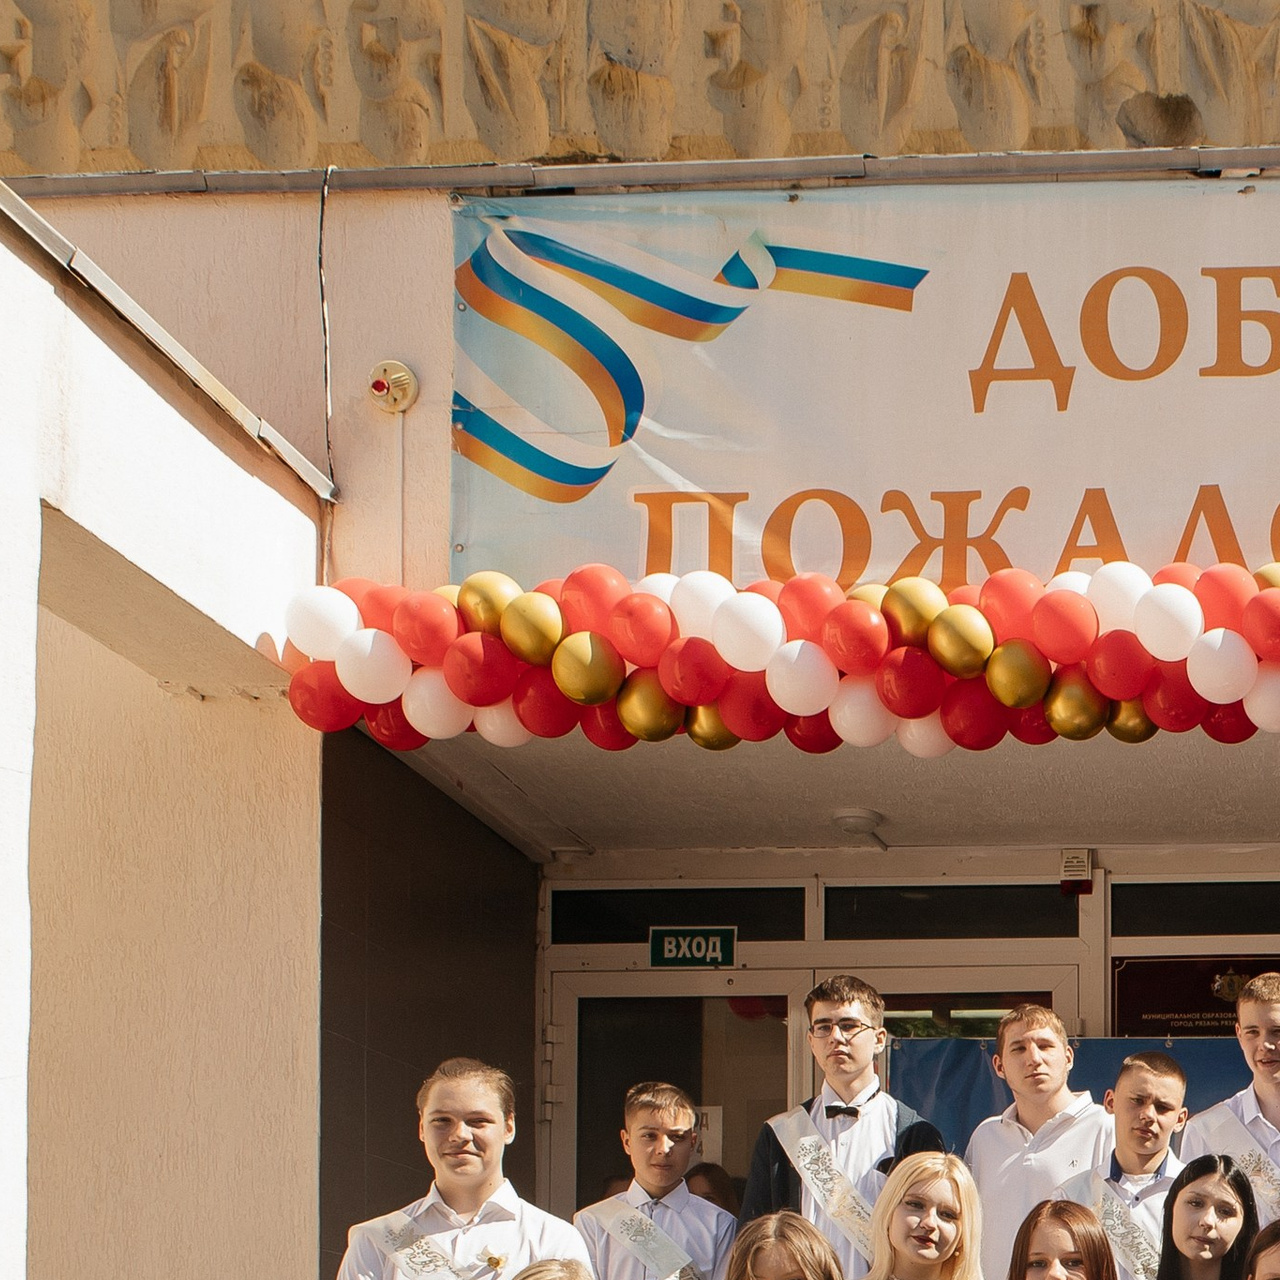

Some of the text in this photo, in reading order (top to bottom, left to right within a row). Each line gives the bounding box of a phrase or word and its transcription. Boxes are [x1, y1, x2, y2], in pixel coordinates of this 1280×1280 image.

[663, 936, 722, 962] ВХОД
[1142, 1012, 1200, 1020] МУНИЦИПАЛЬНОЕ
[1202, 1011, 1237, 1020] ОБРАЗОВА
[1171, 1020, 1194, 1028] ГОРОД
[1195, 1019, 1219, 1027] РЯЗАНЬ
